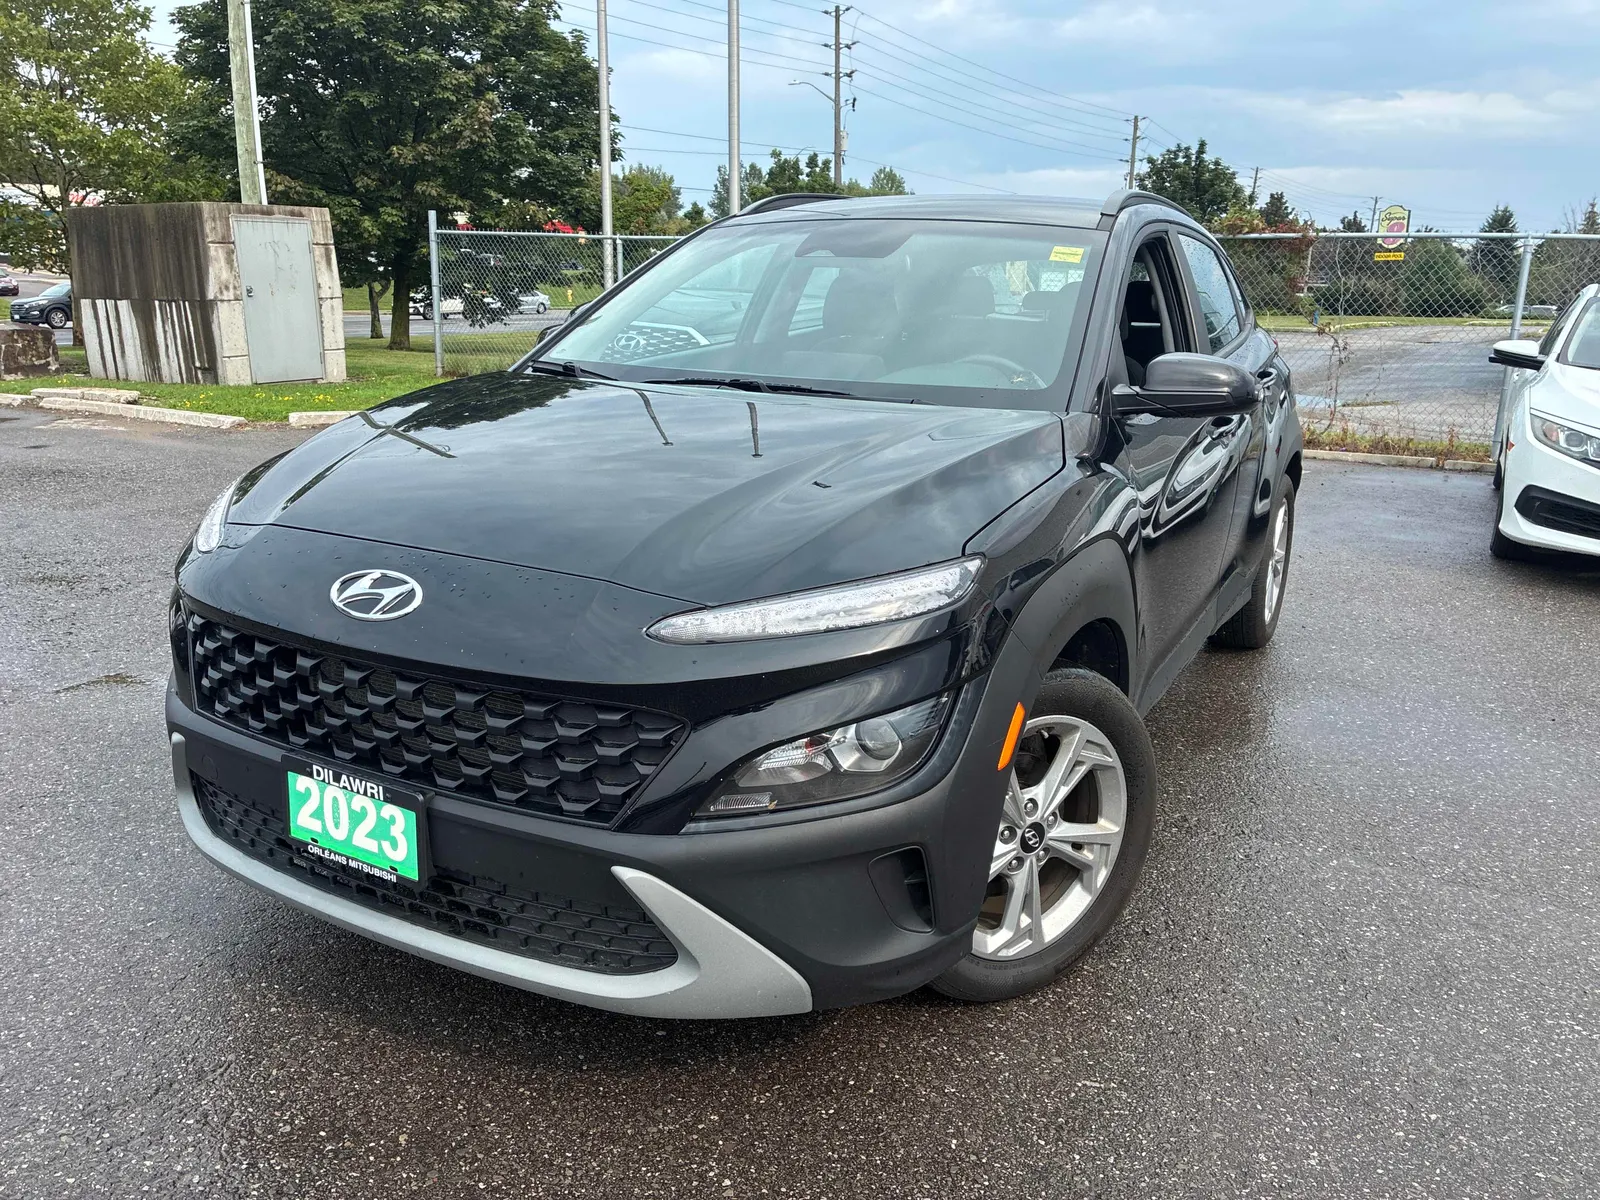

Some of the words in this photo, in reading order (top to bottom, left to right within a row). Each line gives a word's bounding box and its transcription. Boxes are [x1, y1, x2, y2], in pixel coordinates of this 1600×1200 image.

[1381, 211, 1406, 226] Super
[312, 764, 384, 801] DILAWRI
[295, 774, 408, 862] 2023
[307, 844, 347, 865] ORLÉANS
[348, 858, 397, 882] MITSUBISHI
